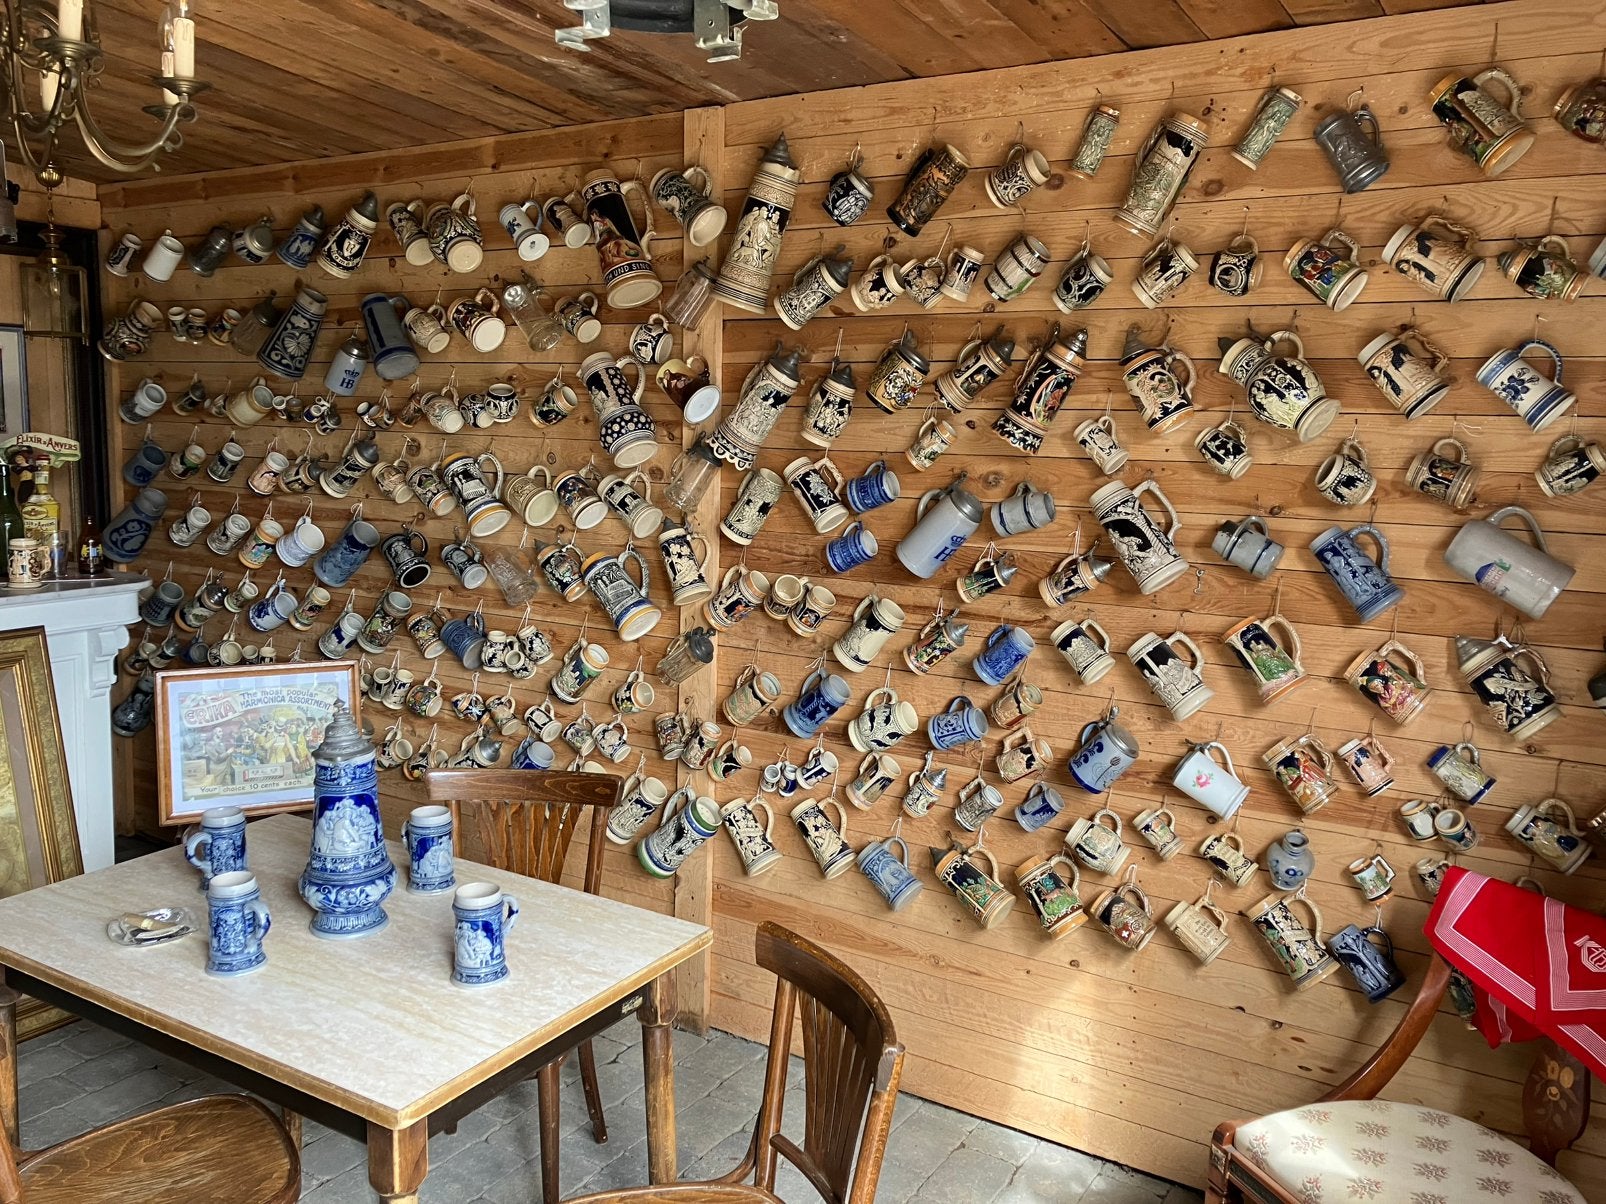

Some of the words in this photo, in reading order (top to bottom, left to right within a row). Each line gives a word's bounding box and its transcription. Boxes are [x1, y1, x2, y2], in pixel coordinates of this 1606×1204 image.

[613, 265, 629, 276] UND
[339, 377, 355, 389] HB
[240, 692, 258, 700] The
[261, 689, 283, 697] most
[286, 688, 319, 699] popular
[240, 695, 286, 709] HARMONICA
[287, 695, 333, 711] ASSORTMENT
[184, 699, 237, 725] ERIKA
